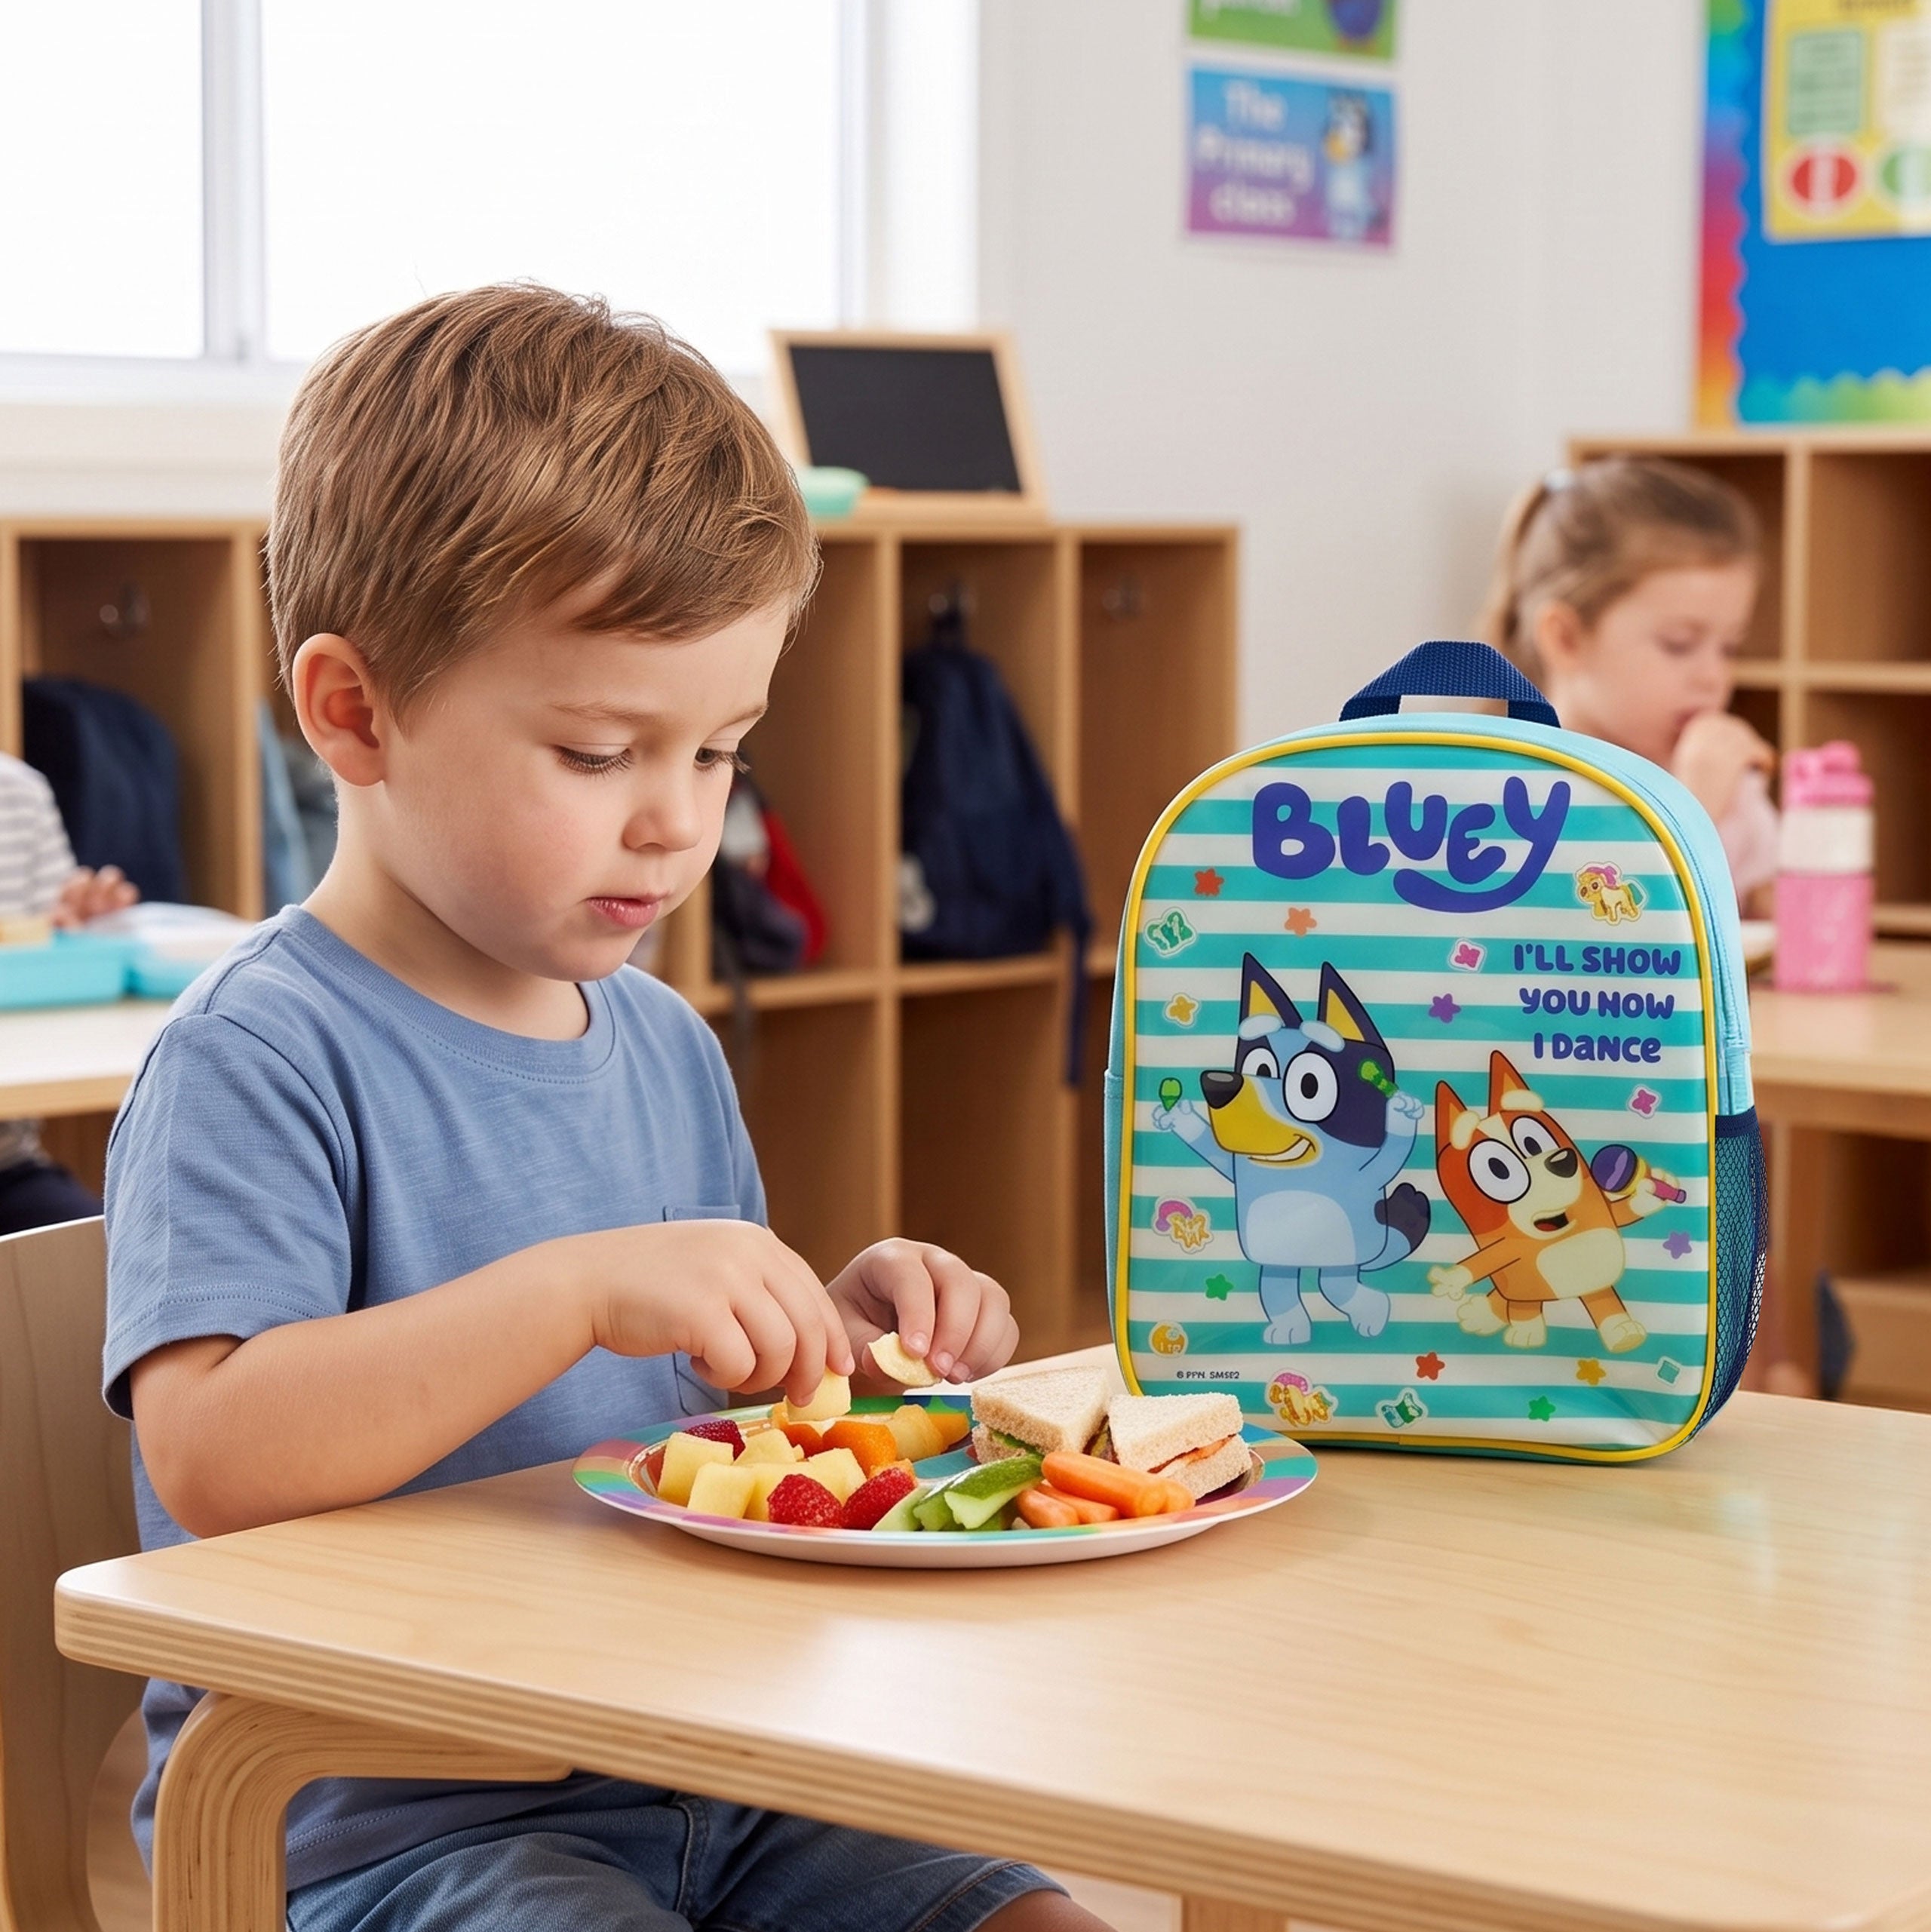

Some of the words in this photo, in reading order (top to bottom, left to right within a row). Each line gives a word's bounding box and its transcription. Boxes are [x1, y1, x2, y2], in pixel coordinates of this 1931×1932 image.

[1251, 776, 1572, 914] BLUEY
[1513, 944, 1574, 972] I'LL
[1581, 945, 1681, 975] SHOW
[1518, 988, 1591, 1016] YOU
[1597, 991, 1675, 1019] NOW
[1533, 1032, 1544, 1059] I
